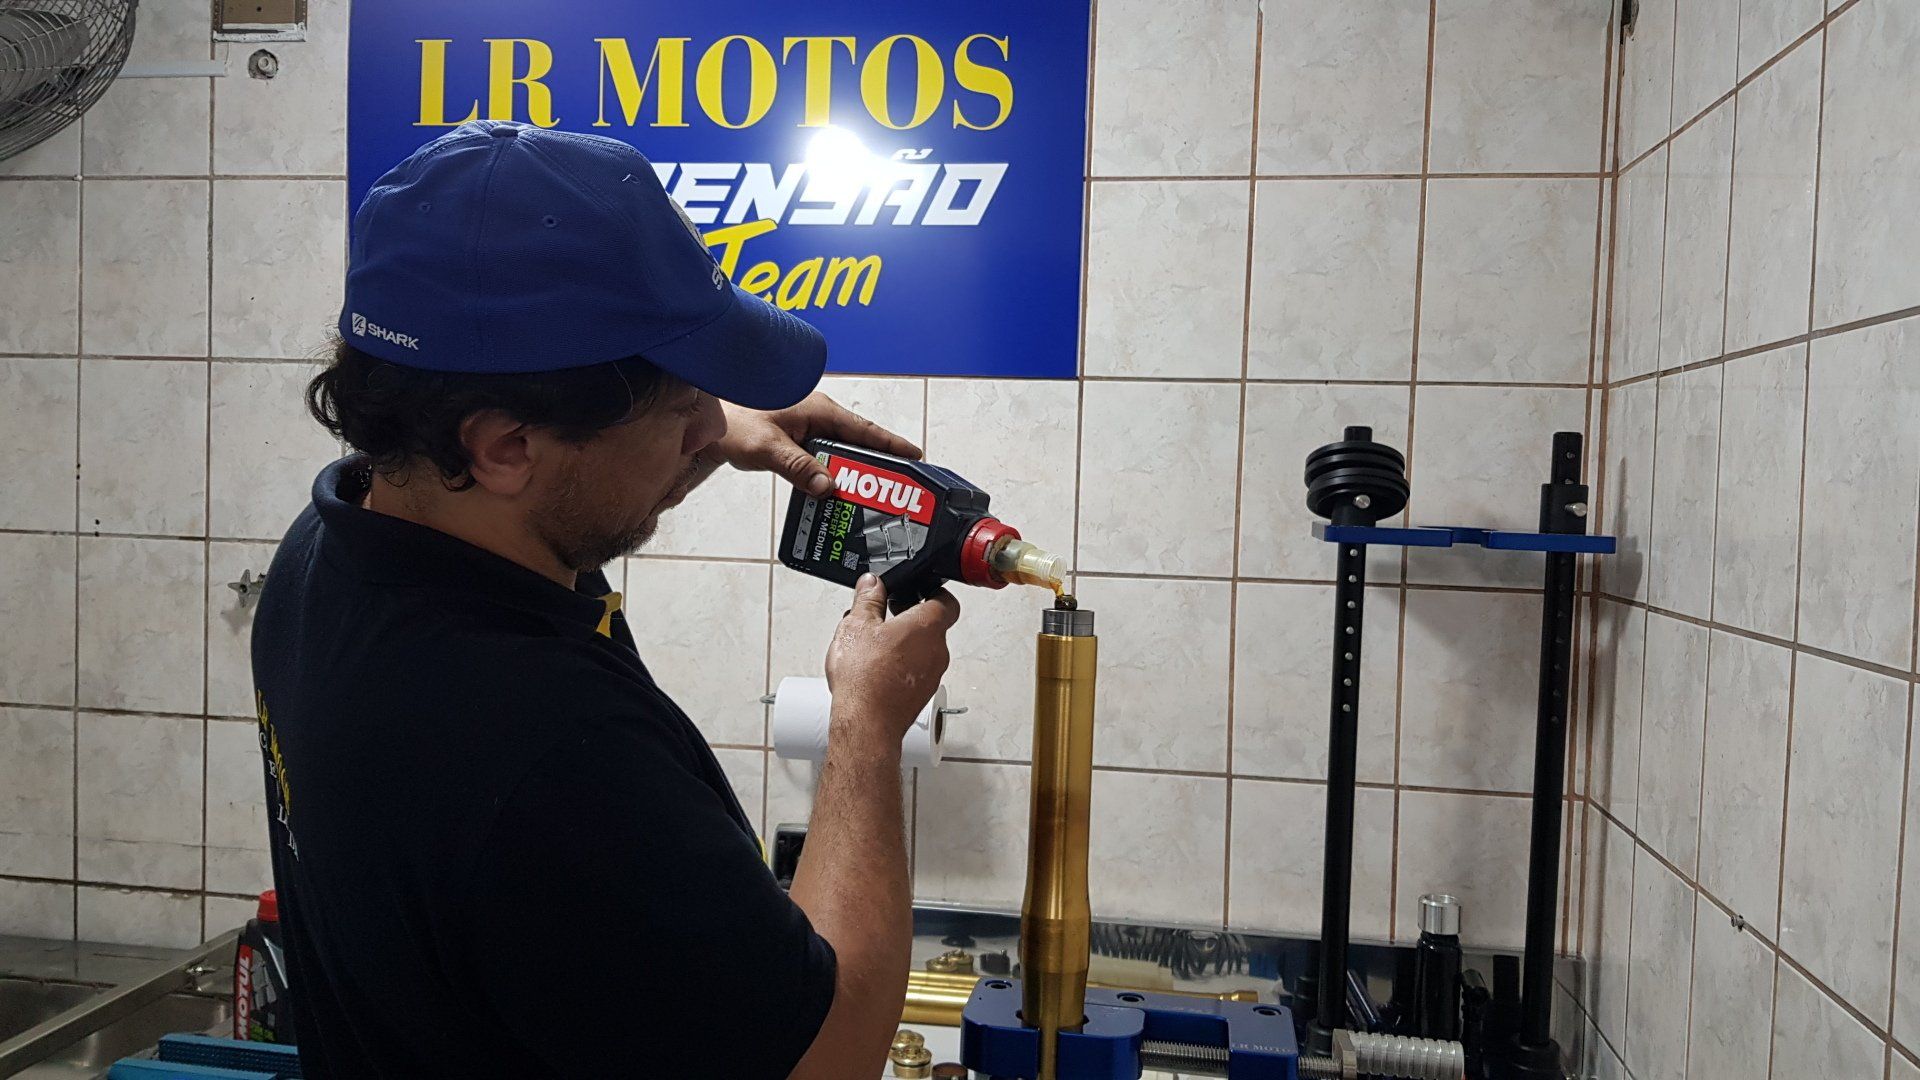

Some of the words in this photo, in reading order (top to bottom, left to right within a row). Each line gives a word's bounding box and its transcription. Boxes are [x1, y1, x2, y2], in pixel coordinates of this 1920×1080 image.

[412, 38, 560, 128] LR
[592, 34, 1014, 130] MOTOS
[702, 218, 882, 311] Team
[367, 322, 419, 350] SHARK
[834, 466, 925, 514] MOTUL
[829, 500, 843, 537] EXPERT
[836, 502, 853, 540] FORK
[829, 540, 842, 562] OIL
[237, 956, 250, 1040] MOTUL
